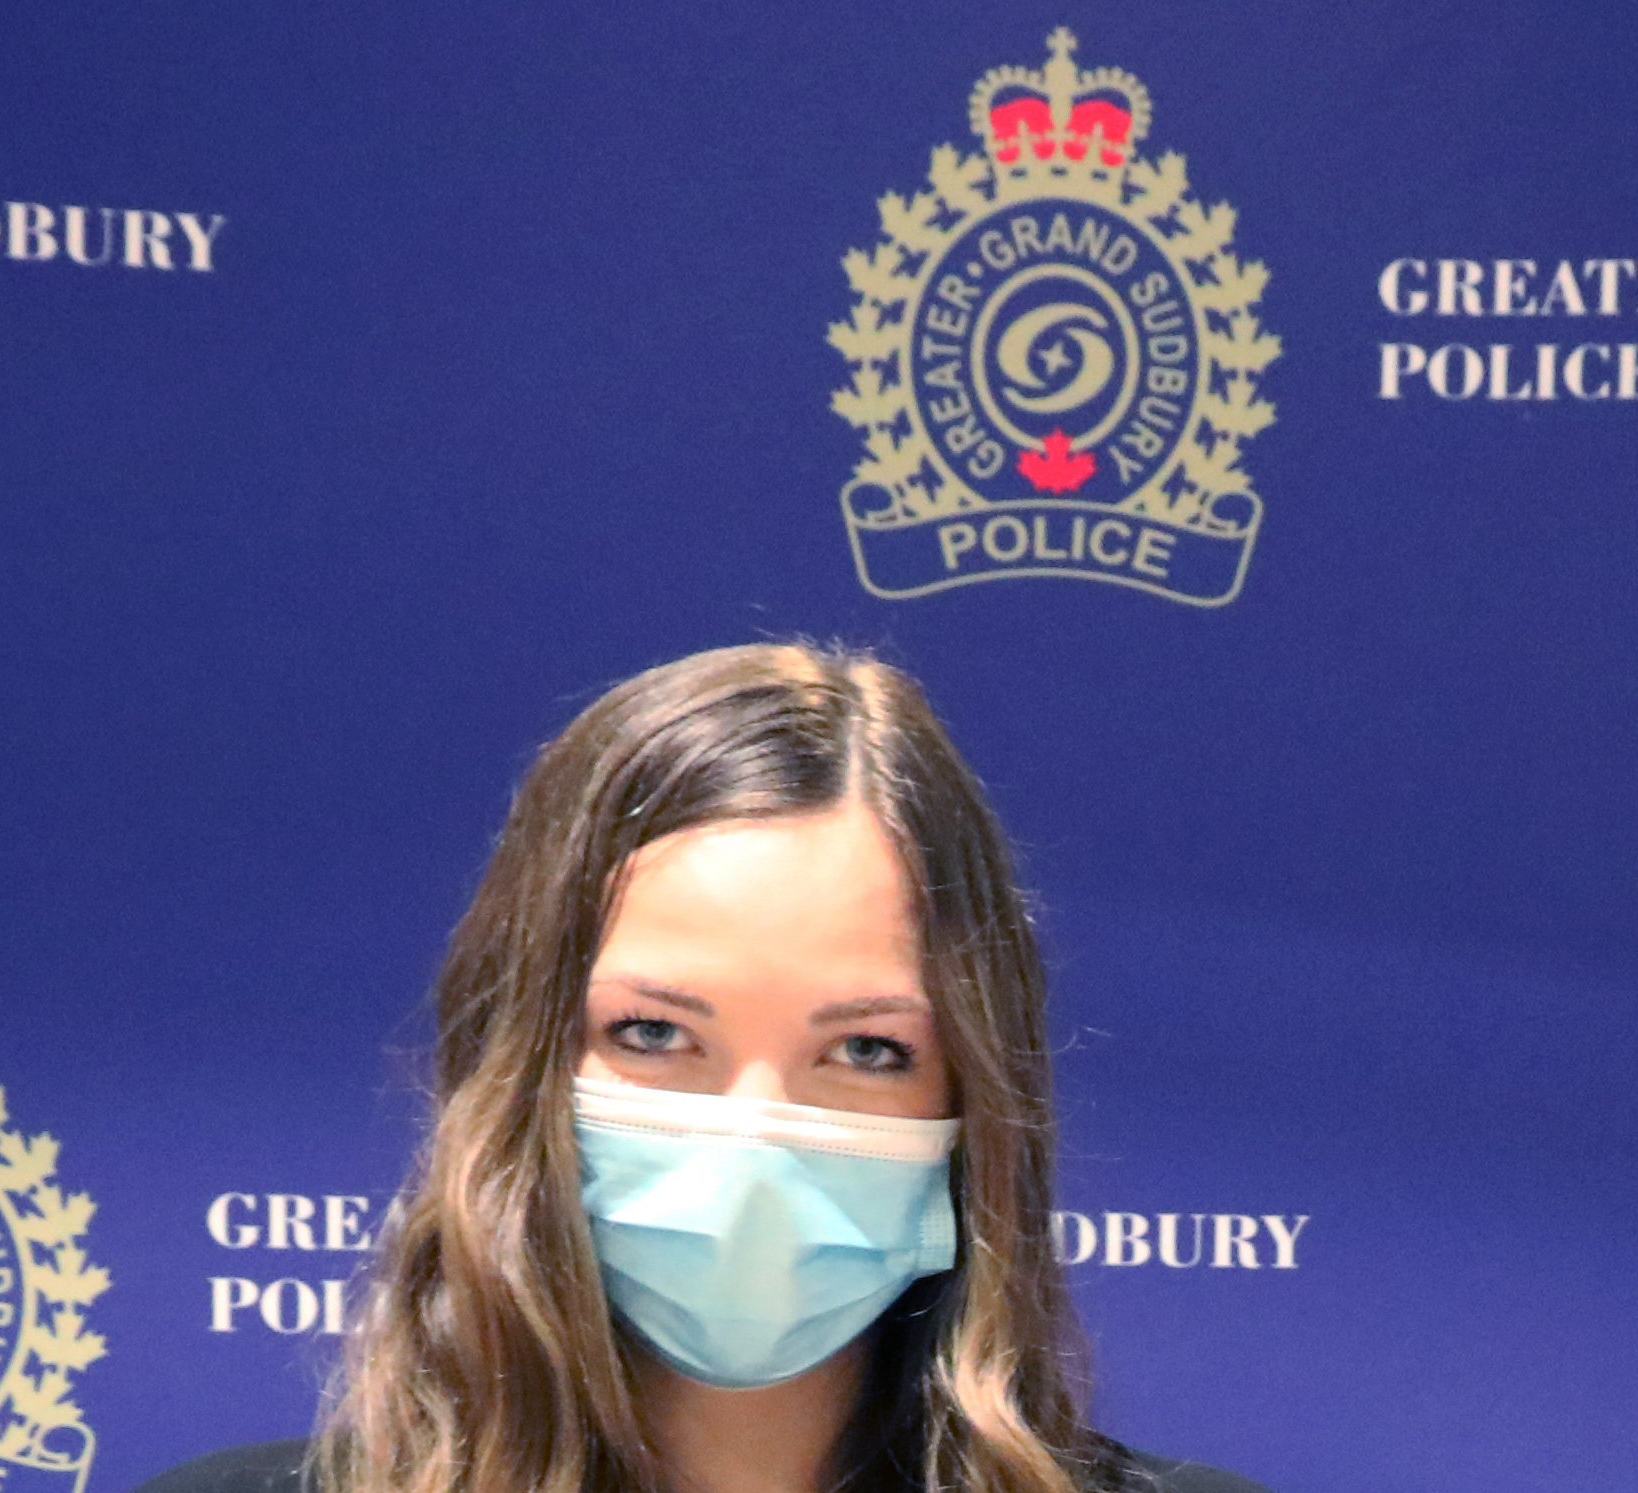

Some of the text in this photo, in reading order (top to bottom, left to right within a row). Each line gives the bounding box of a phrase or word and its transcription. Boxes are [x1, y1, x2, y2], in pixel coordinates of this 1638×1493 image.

[978, 213, 1139, 276] GRAND
[1108, 271, 1189, 485] SUDBURY
[937, 515, 1179, 579] POLICE
